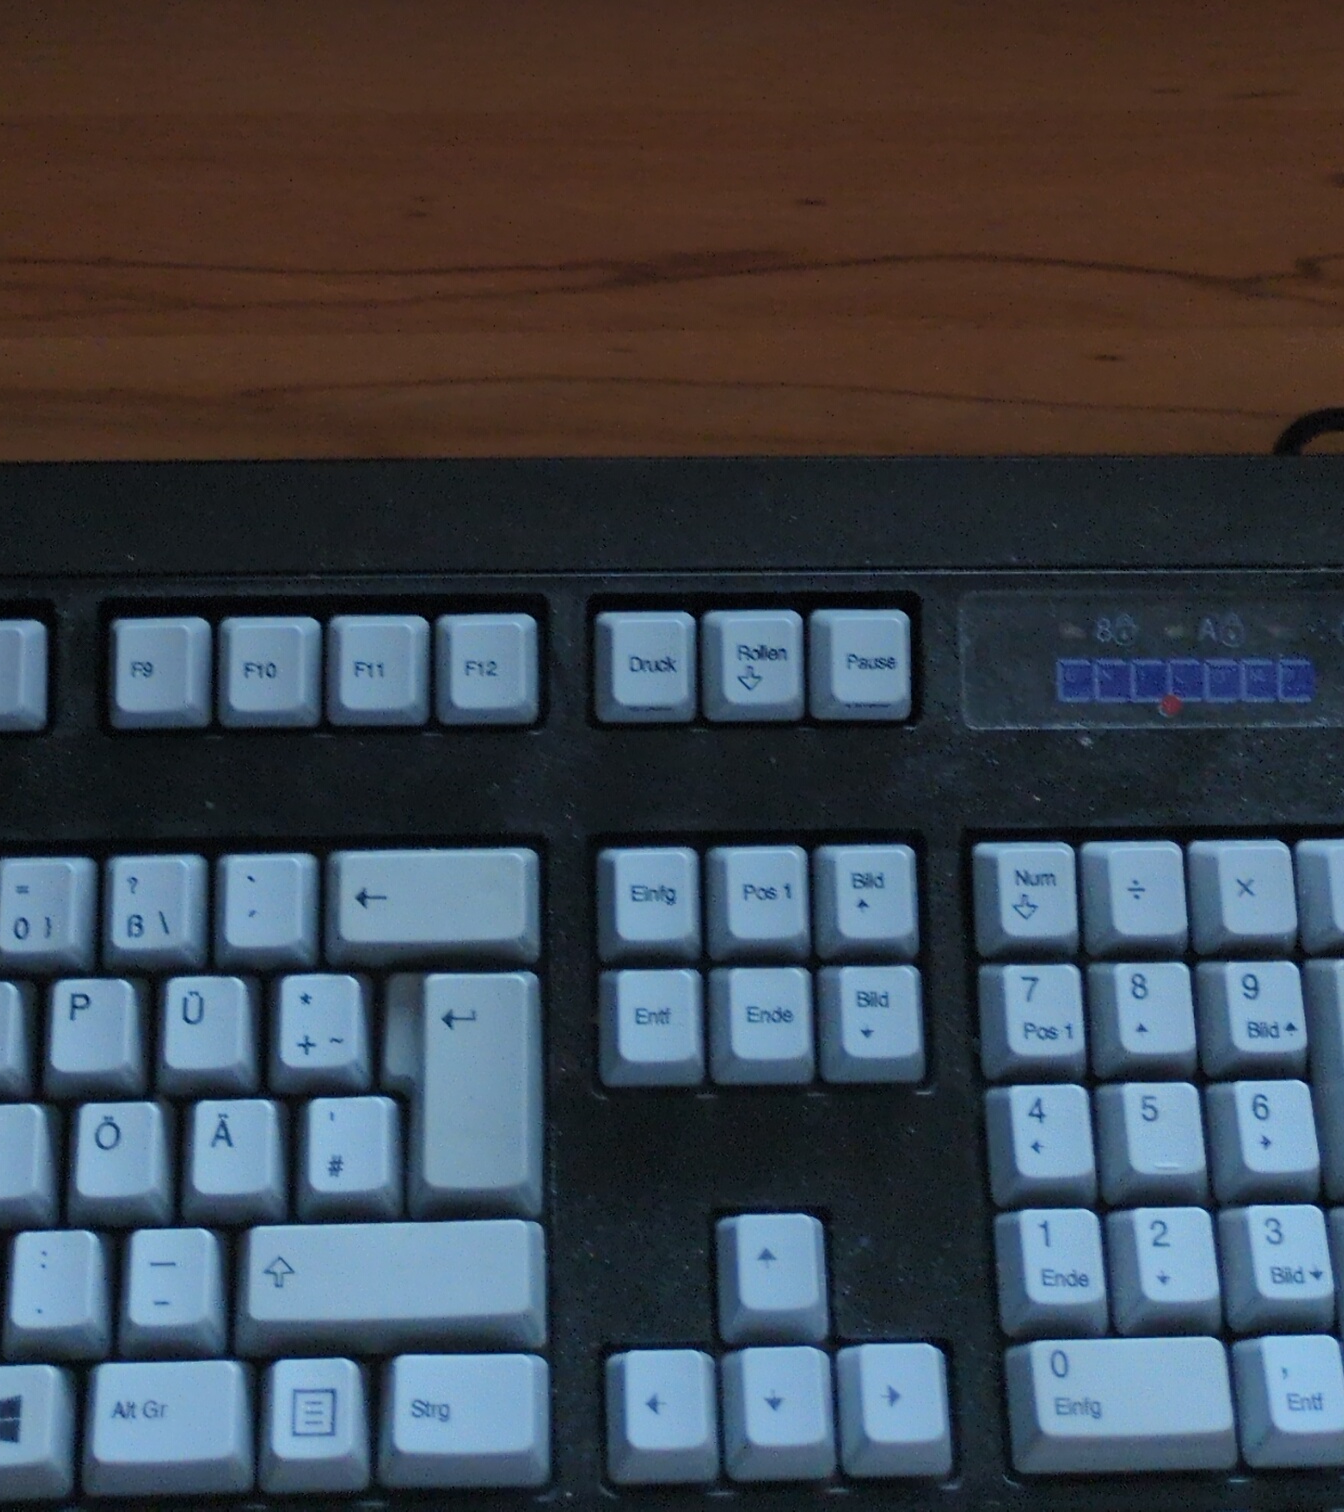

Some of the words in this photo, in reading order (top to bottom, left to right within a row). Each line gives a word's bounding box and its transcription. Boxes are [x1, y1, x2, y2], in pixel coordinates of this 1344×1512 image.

[737, 644, 787, 662] Rollen
[847, 653, 897, 671] Pause
[131, 662, 153, 678] F9
[244, 662, 276, 679] F10
[353, 661, 385, 677] F11
[464, 660, 497, 676] F12
[629, 656, 676, 673] Druck
[852, 872, 884, 889] Bild
[1015, 870, 1056, 887] Num
[631, 885, 676, 905] Einfg
[743, 884, 777, 900] Pos
[13, 917, 29, 940] 0
[1021, 976, 1040, 1002] 7
[1131, 973, 1149, 1000] 8
[1242, 973, 1260, 1000] 9
[70, 993, 91, 1021] P
[182, 991, 205, 1025] Ü
[856, 991, 889, 1008] Bild
[635, 1008, 672, 1025] Entf
[746, 1006, 793, 1023] Ende
[1024, 1022, 1058, 1040] Pos
[1247, 1021, 1280, 1039] Bild
[297, 1036, 316, 1055] +
[1028, 1098, 1046, 1123] 4
[1142, 1096, 1159, 1122] 5
[1252, 1094, 1270, 1121] 6
[95, 1116, 121, 1150] Ö
[211, 1114, 234, 1148] Ä
[328, 1156, 344, 1177] #
[1038, 1221, 1050, 1247] 1
[1150, 1220, 1170, 1247] 2
[1265, 1218, 1283, 1245] 3
[1041, 1269, 1089, 1287] Ende
[1270, 1266, 1305, 1284] Bild
[1050, 1350, 1069, 1378] 0
[111, 1401, 136, 1419] Alt
[142, 1400, 167, 1419] Gr
[411, 1399, 450, 1422] Strg
[1054, 1397, 1102, 1420] Einfg
[1286, 1393, 1323, 1411] Entf
